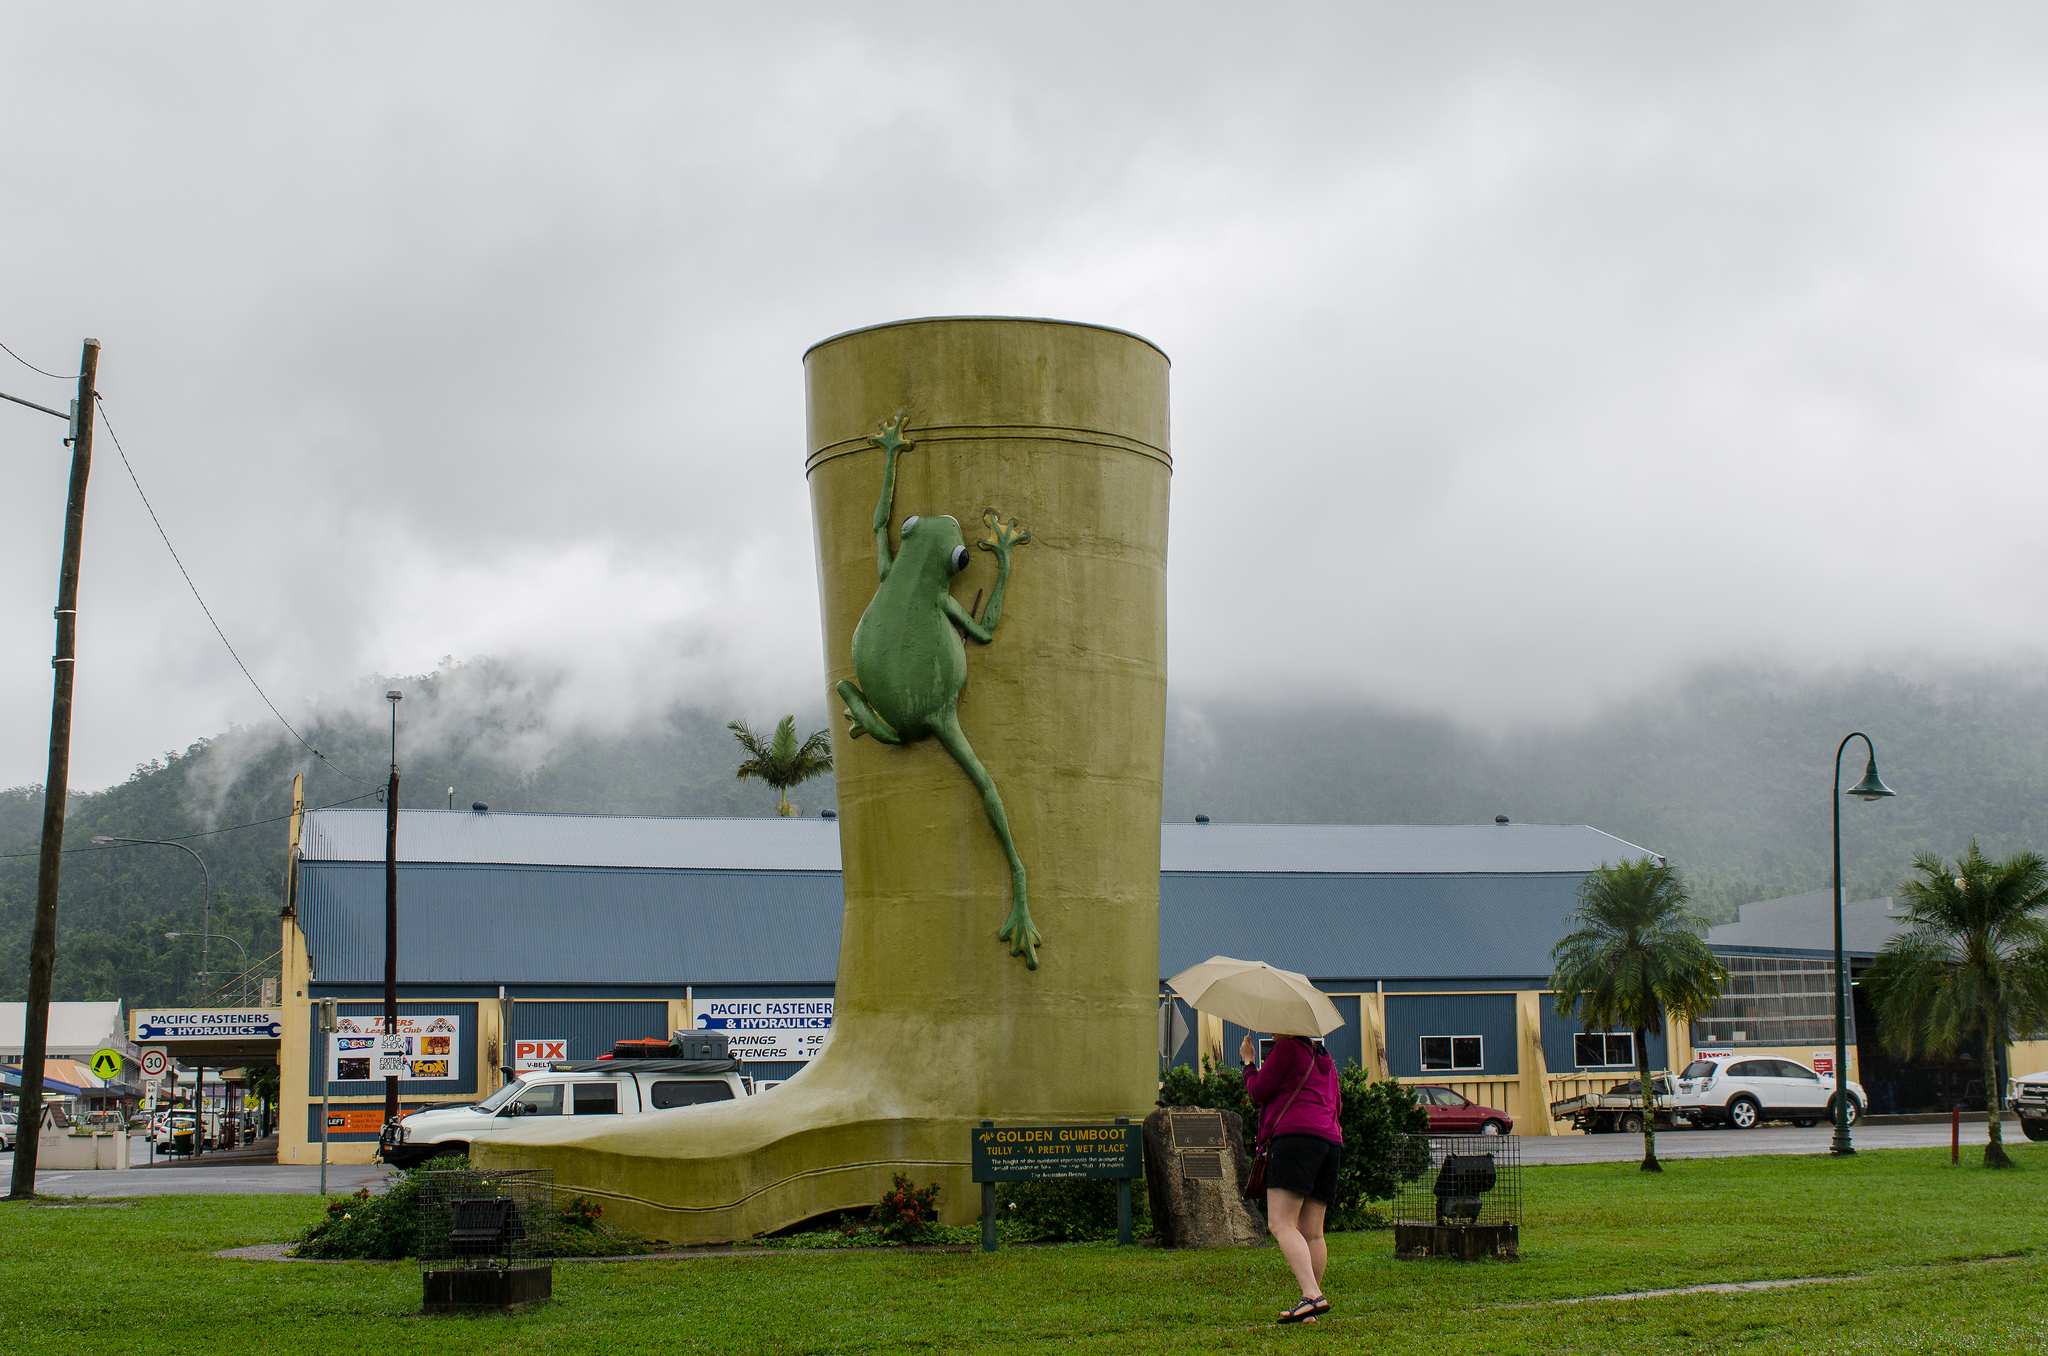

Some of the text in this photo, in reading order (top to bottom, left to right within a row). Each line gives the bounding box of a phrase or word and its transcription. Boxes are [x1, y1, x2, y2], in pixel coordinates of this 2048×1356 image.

[711, 1003, 762, 1014] PACIFIC
[151, 1014, 269, 1024] PACIFIC FASTENERS
[726, 1018, 825, 1029] & HYDRAULICS
[165, 1027, 175, 1035] &
[178, 1026, 255, 1035] HYDRAULICS
[402, 1026, 422, 1034] Club
[383, 1034, 401, 1043] DOG
[728, 1036, 776, 1045] ARINGS
[381, 1041, 405, 1049] SHOW
[517, 1043, 564, 1058] PIX
[146, 1057, 162, 1068] 30
[414, 1061, 444, 1073] FOX
[996, 1130, 1053, 1142] GOLDEN
[1059, 1129, 1127, 1141] GUMBOOT
[987, 1146, 1013, 1155] TULLY
[1038, 1145, 1071, 1154] PRETTY
[1075, 1144, 1093, 1153] WET
